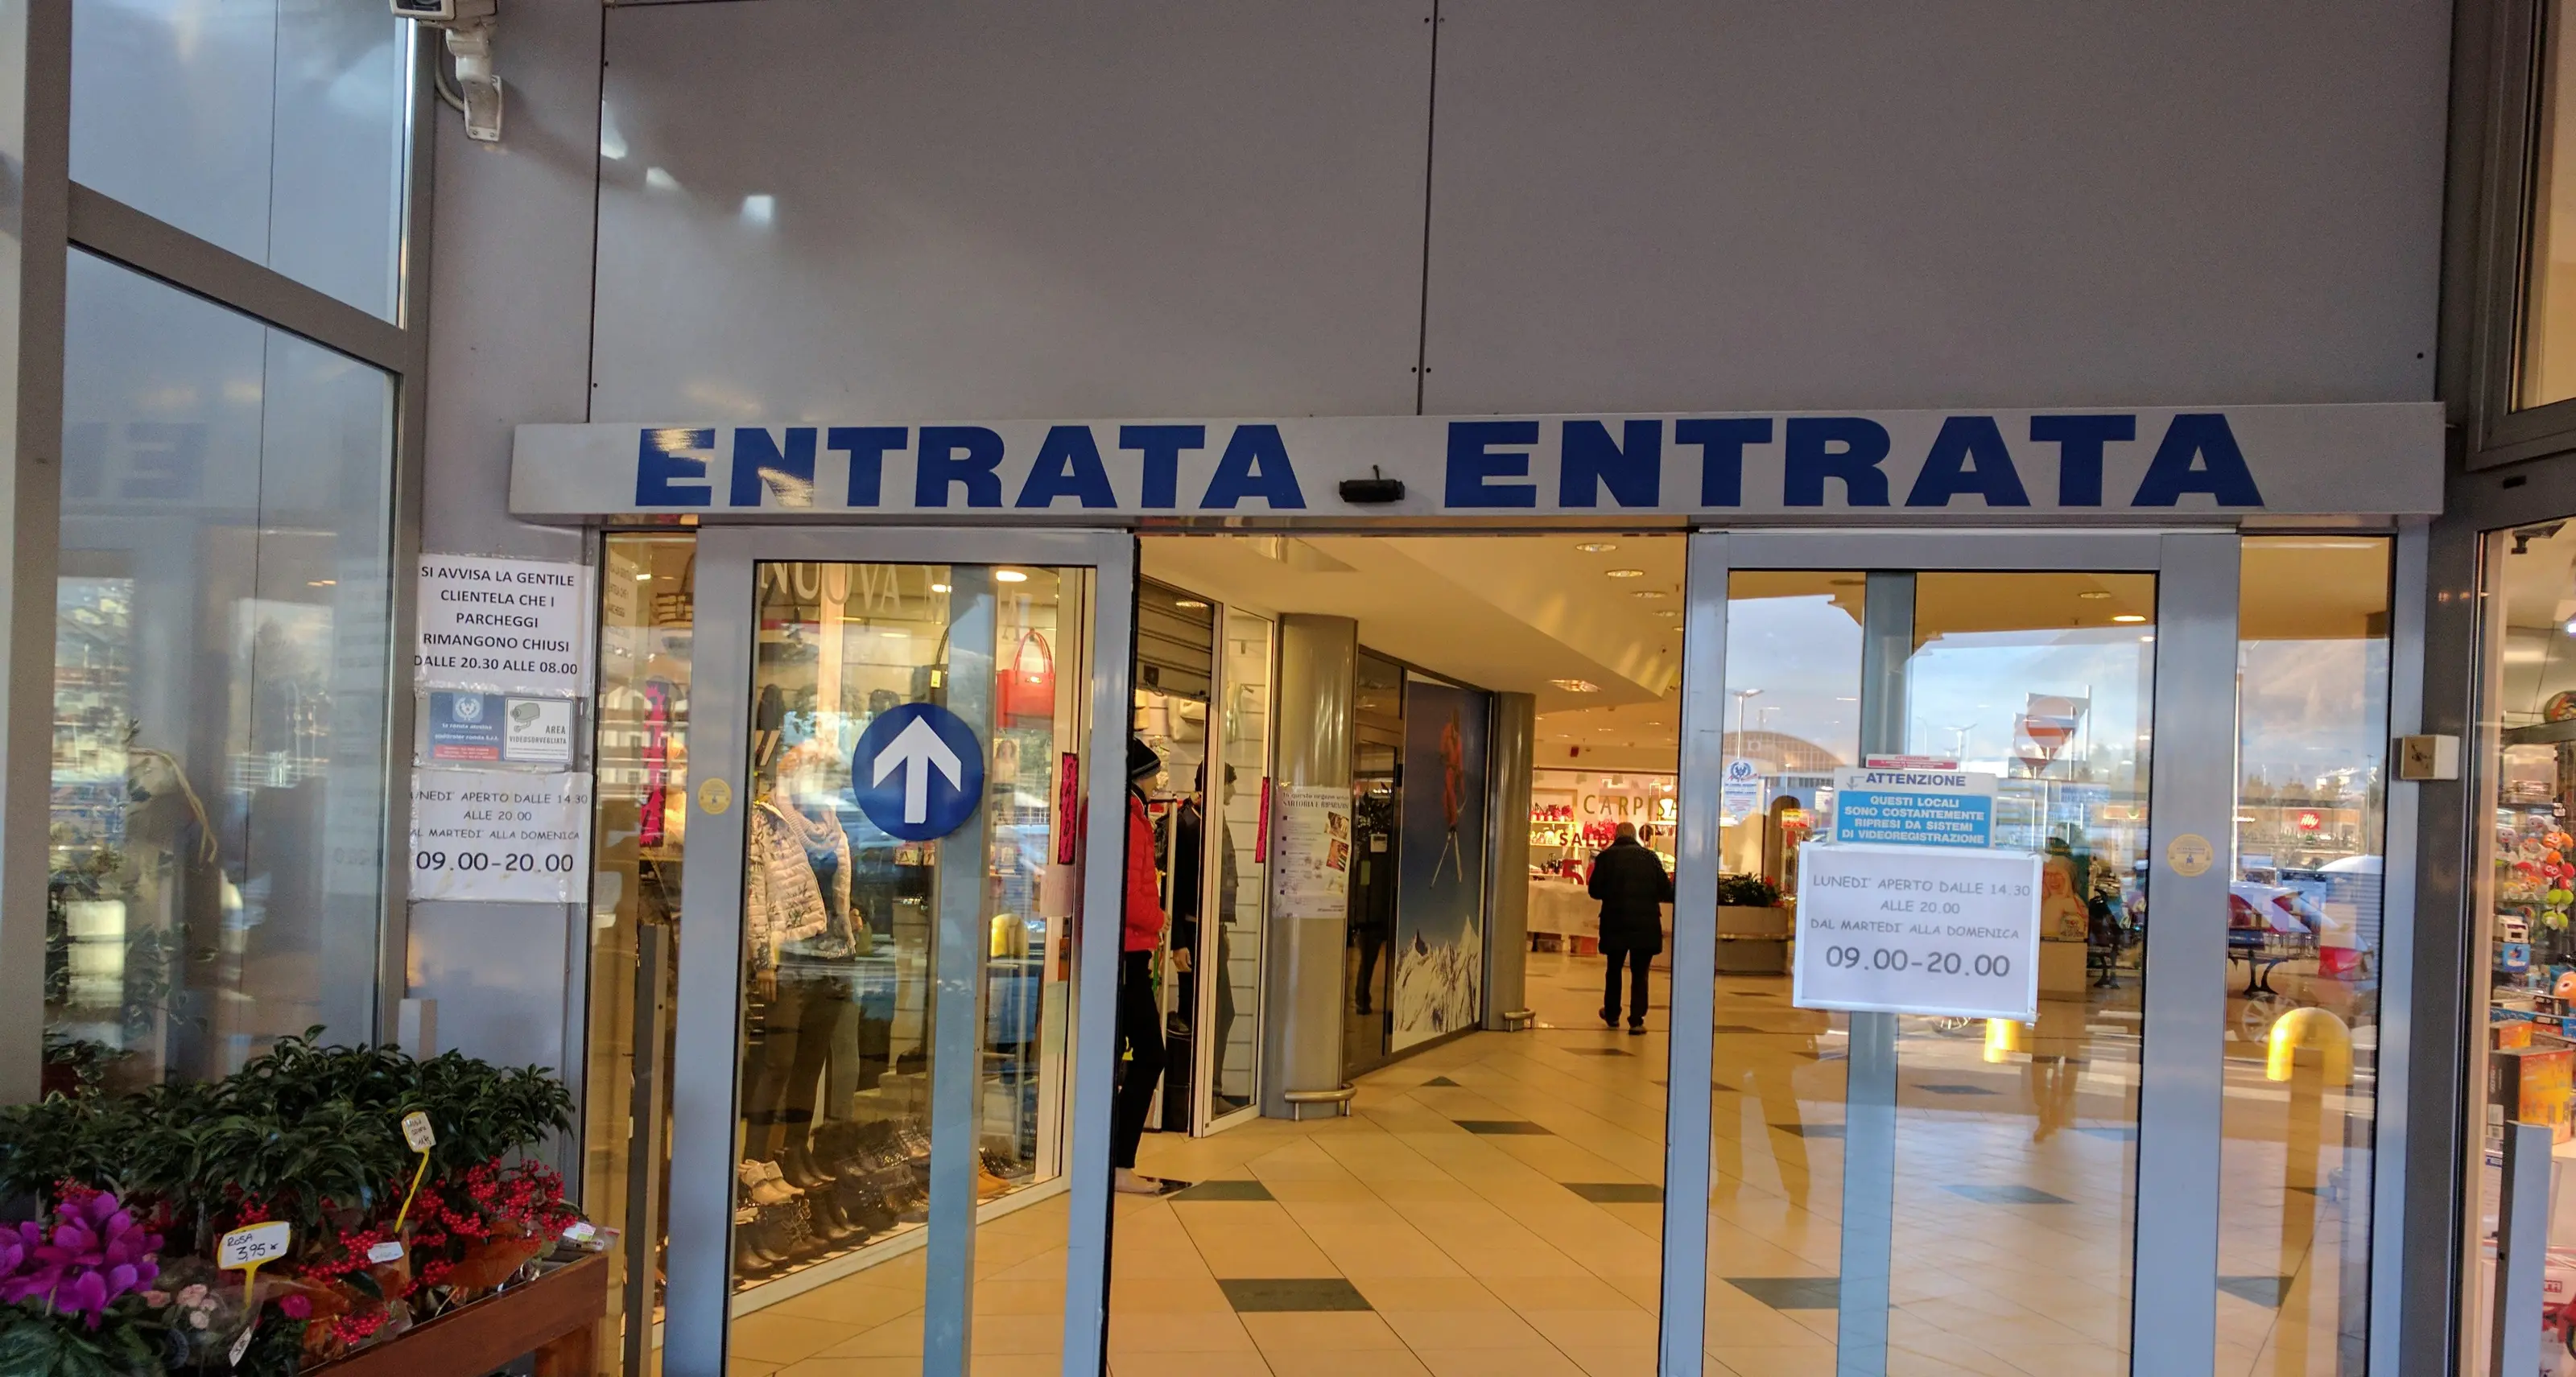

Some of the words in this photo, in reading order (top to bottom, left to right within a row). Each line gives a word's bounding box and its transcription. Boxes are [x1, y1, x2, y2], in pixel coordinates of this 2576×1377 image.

[635, 425, 1307, 509] ENTRATA
[1444, 414, 2265, 508] ENTRATA
[421, 567, 433, 577] SI
[438, 568, 491, 581] AVVISA
[496, 571, 512, 583] LA
[517, 572, 575, 587] GENTILE
[441, 590, 514, 604] CLIENTELA
[519, 595, 546, 607] CHE
[551, 597, 555, 607] I
[456, 612, 539, 628] PARCHEGGI
[423, 633, 518, 649] RIMANGONO
[522, 638, 569, 652] CHIUSI
[415, 655, 456, 667] DALLE
[460, 658, 498, 670] 20.30
[503, 660, 535, 672] ALLE
[539, 662, 577, 674] 08.00
[545, 725, 566, 735] AREA
[509, 736, 567, 744] VIDEOSORVEGLIATA
[1866, 773, 1967, 786] ATTENZIONE
[460, 792, 509, 803] APERTO
[514, 794, 551, 804] DALLE
[1870, 796, 1913, 806] QUESTI
[1918, 798, 1959, 808] LOCALI
[463, 810, 492, 820] ALLE
[1063, 763, 1073, 854] SALDI
[1844, 806, 1877, 816] SONO
[1882, 808, 1984, 821] COSTANTEMENTE
[1855, 818, 1900, 829] RIPRESI
[1905, 820, 1921, 830] DA
[1926, 821, 1972, 831] SISTEMI
[2301, 813, 2319, 829] illy
[408, 829, 423, 838] AL
[489, 831, 516, 839] ALLA
[521, 831, 580, 840] DOMENICA
[1559, 832, 1610, 848] SALD
[1842, 829, 1854, 839] DI
[1858, 830, 1984, 844] VIDEOREGISTRAZIONE
[416, 851, 574, 872] 09.00-20.00
[1813, 875, 1871, 888] LUNEDI'
[1877, 879, 1933, 892] APERTO
[1939, 881, 1983, 894] DALLE
[1990, 884, 2030, 897] 14.30
[1880, 900, 1913, 912] ALLE
[1920, 901, 1960, 914] 20.00
[1810, 918, 1835, 930] DAL
[1909, 924, 1941, 935] ALLA
[1946, 926, 2019, 939] DOMENICA
[1826, 946, 2010, 977] 09.00-20.00
